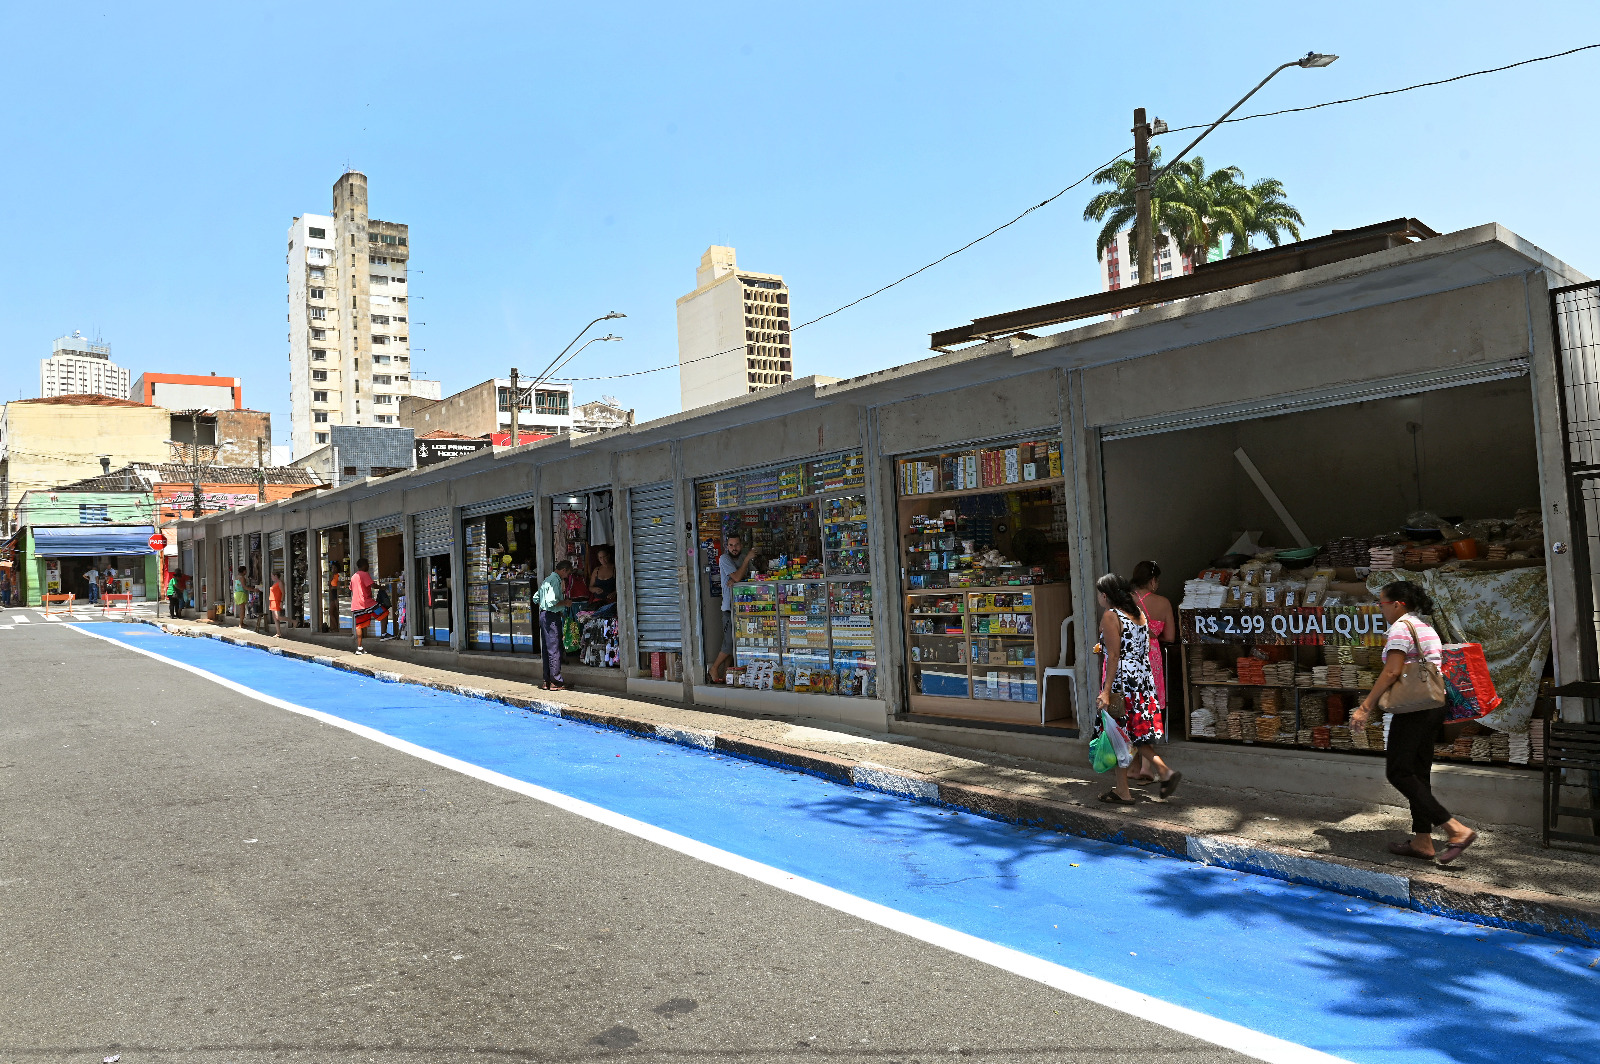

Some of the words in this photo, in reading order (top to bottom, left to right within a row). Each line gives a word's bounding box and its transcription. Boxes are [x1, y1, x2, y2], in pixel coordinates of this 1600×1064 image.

[1195, 615, 1219, 634] R$
[1224, 615, 1265, 634] 2.99
[1271, 614, 1391, 638] QUALQUE
